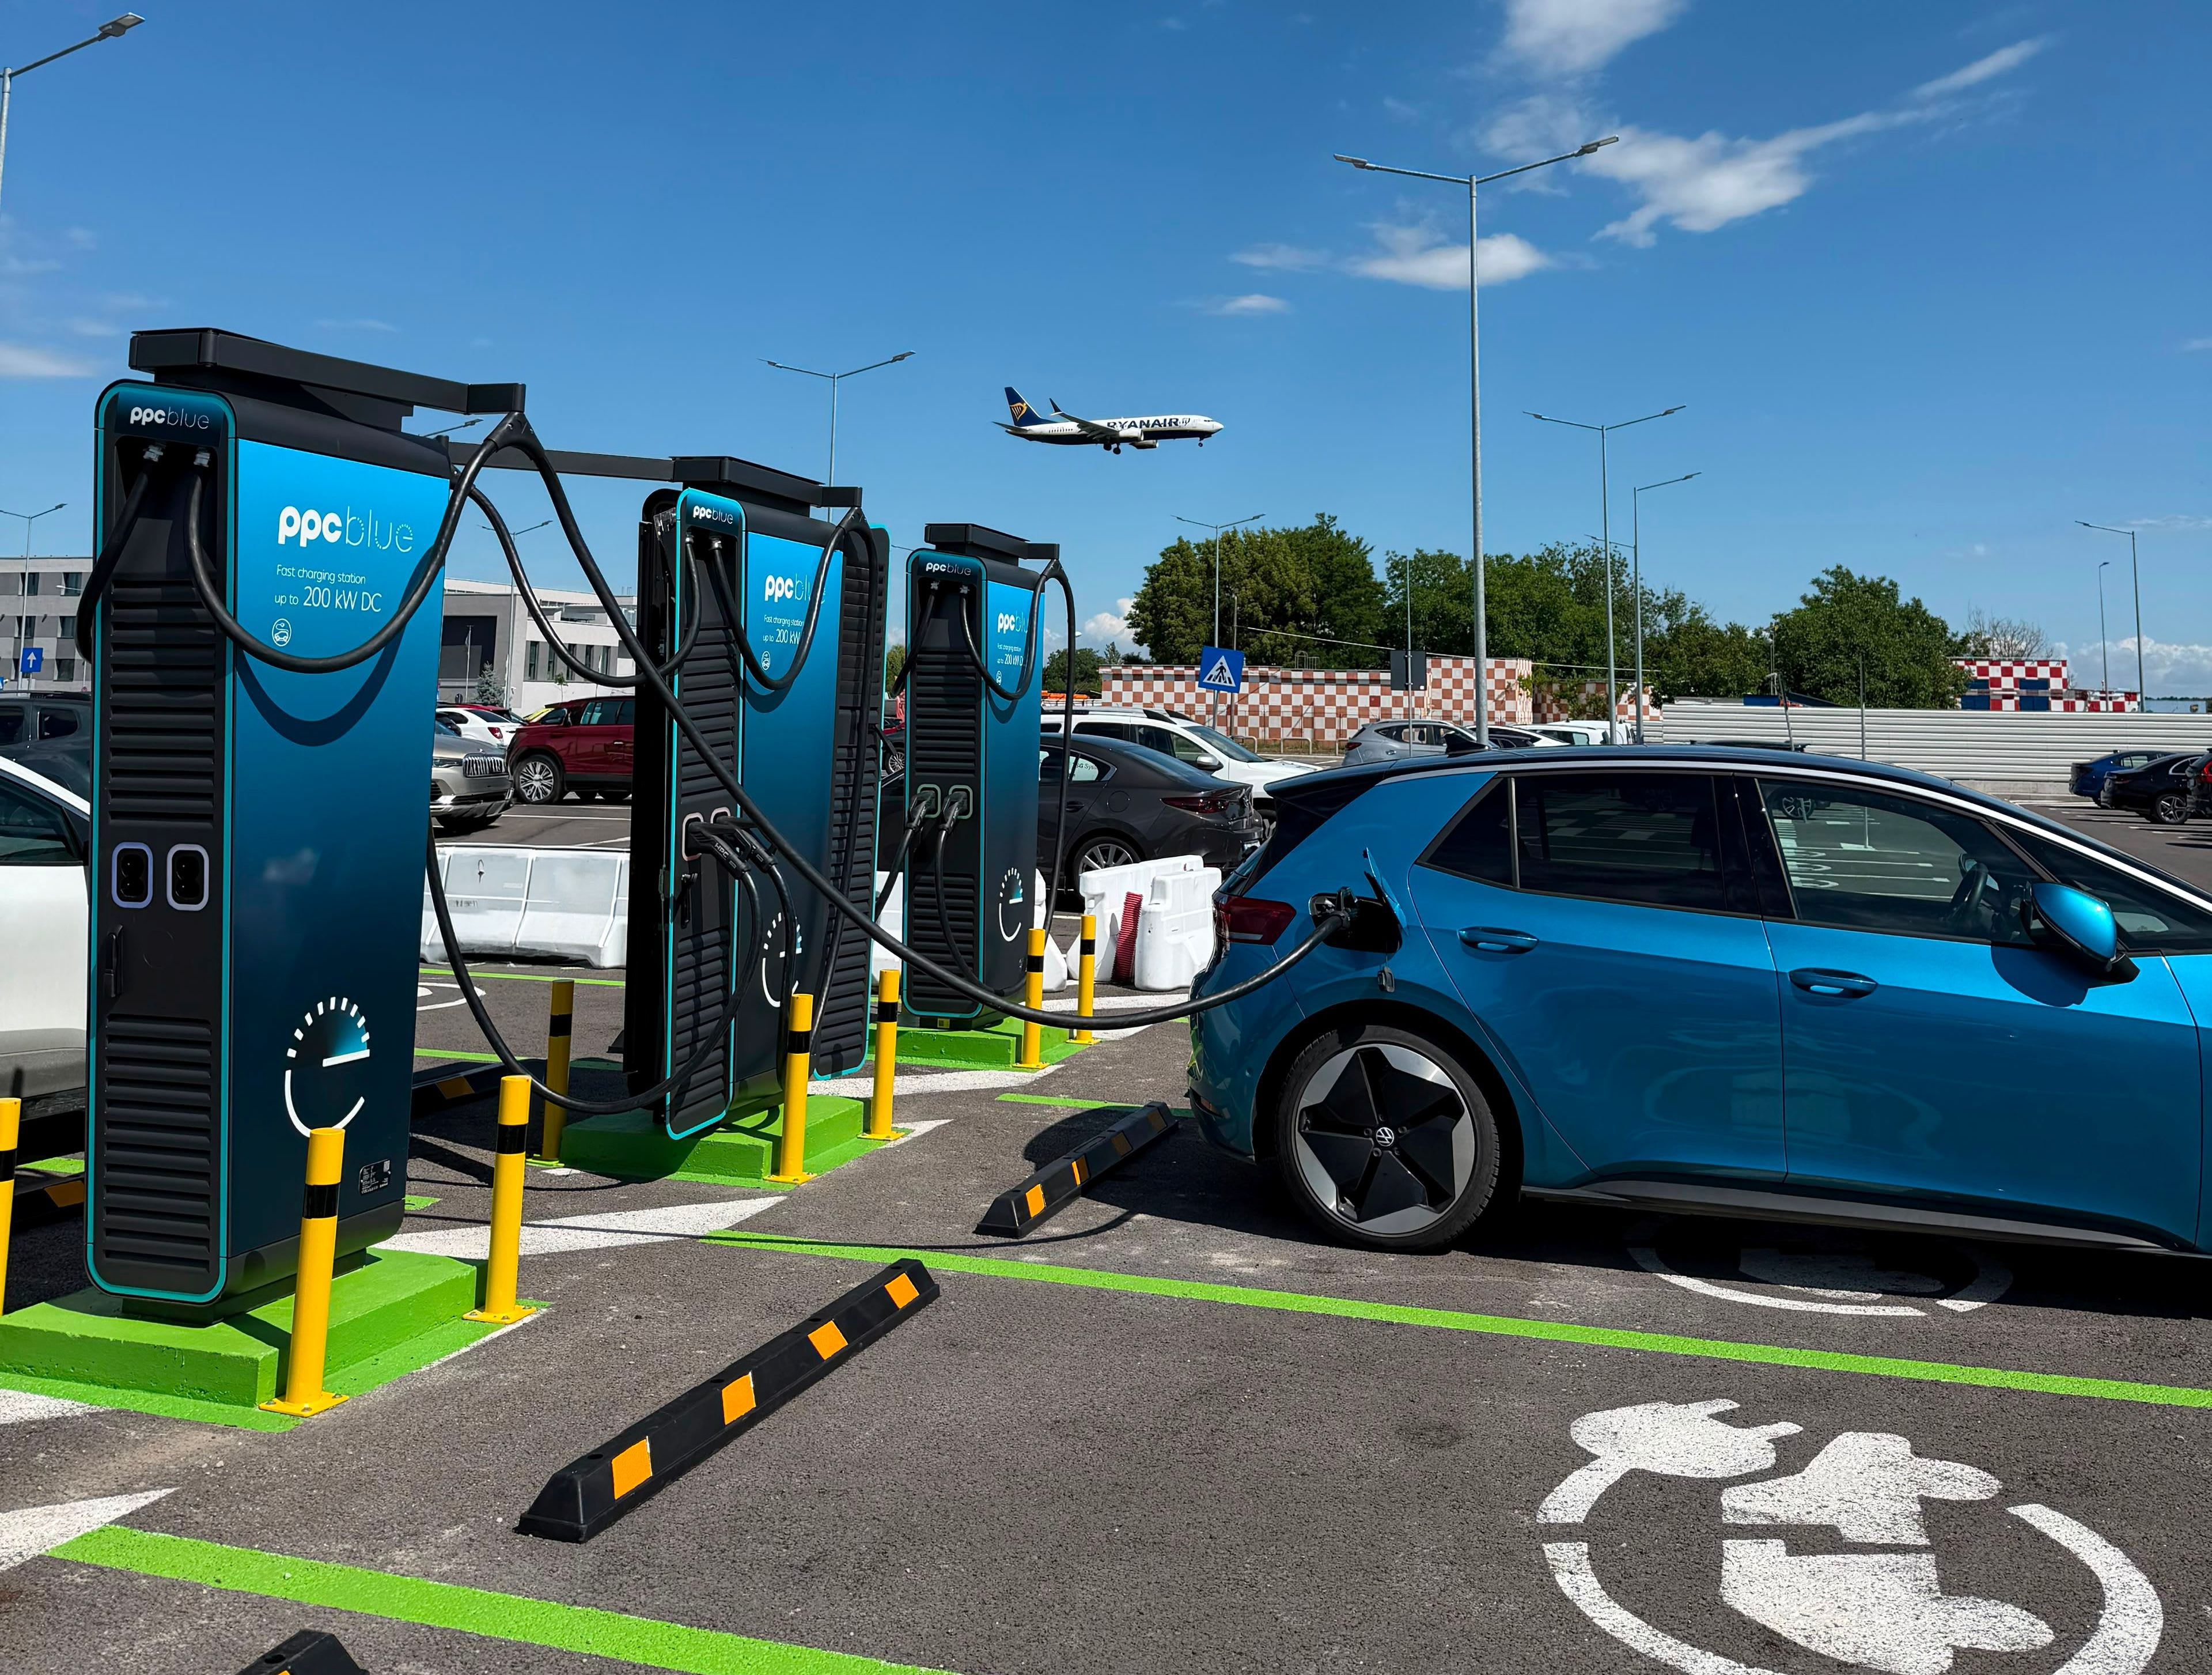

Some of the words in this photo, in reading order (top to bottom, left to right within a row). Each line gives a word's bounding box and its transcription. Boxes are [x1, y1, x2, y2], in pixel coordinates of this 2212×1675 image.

[130, 407, 209, 429] ppcblue
[1107, 418, 1179, 429] RYANAIR
[693, 505, 733, 524] ppcblue
[278, 506, 413, 553] ppcblue
[276, 564, 296, 577] Fast
[297, 568, 335, 584] charging
[338, 573, 366, 584] station
[926, 562, 971, 576] ppcblue
[765, 573, 826, 604] ppcbl
[275, 595, 286, 606] up
[289, 594, 299, 604] to
[303, 586, 331, 608] 200
[335, 589, 358, 610] kW
[361, 592, 382, 612] DC
[776, 628, 789, 643] 200
[790, 630, 801, 644] kW
[714, 842, 729, 858] HPC
